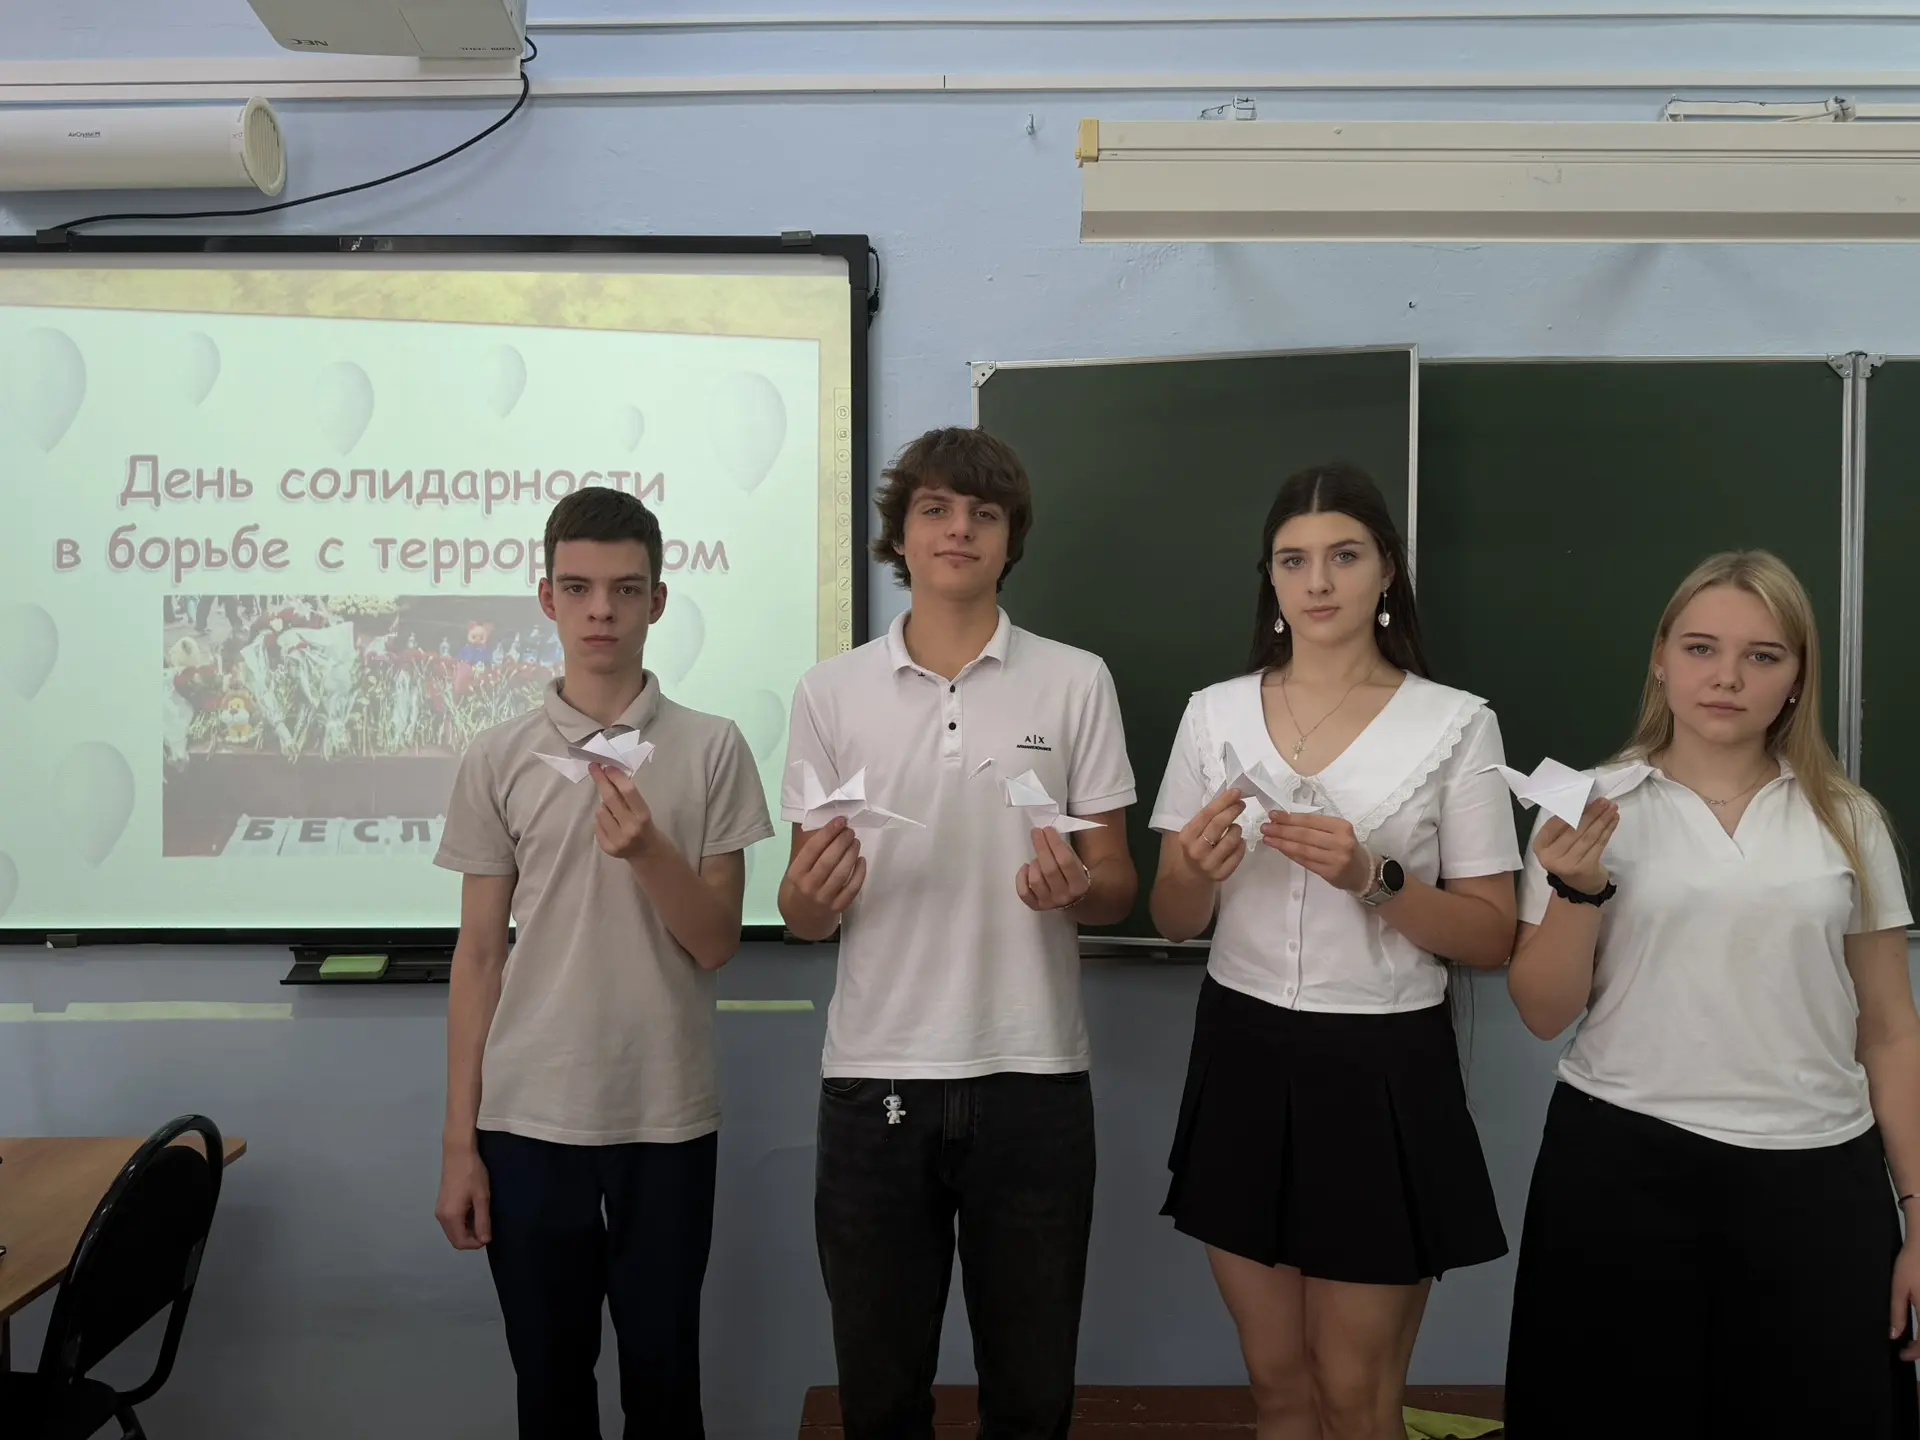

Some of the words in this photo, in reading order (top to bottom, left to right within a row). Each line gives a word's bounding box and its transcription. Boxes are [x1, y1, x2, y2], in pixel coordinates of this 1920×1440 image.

[290, 38, 329, 47] NEC
[119, 454, 254, 508] День
[280, 467, 665, 515] солидарности
[56, 538, 82, 569] в
[108, 522, 290, 584] борьбе
[318, 537, 345, 569] с
[372, 537, 730, 584] террором
